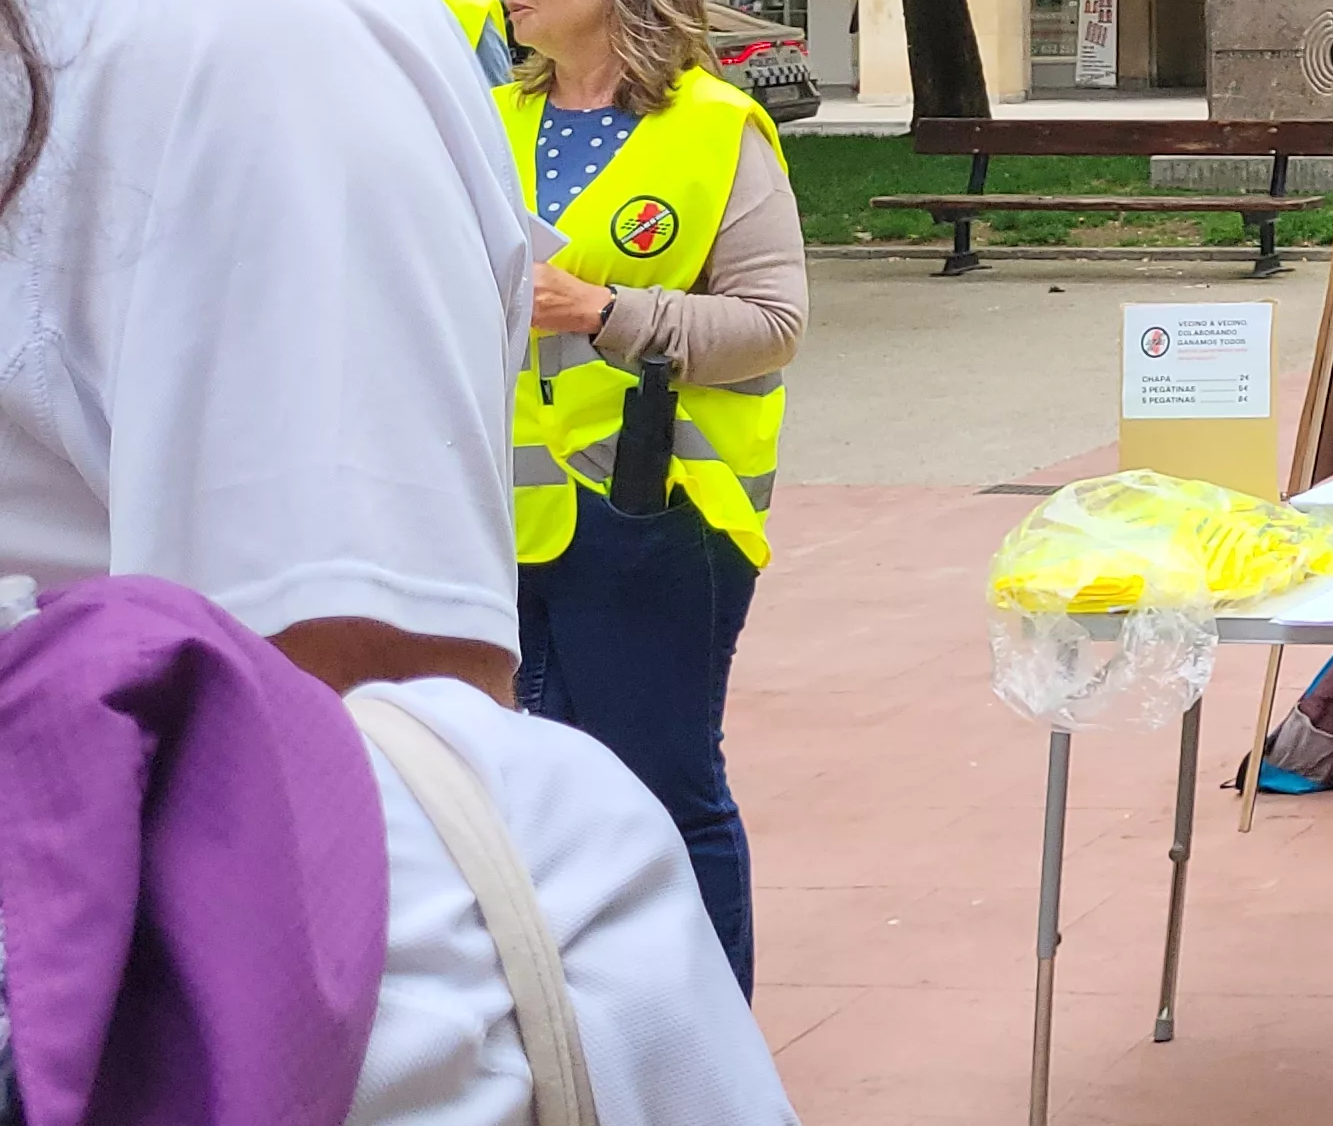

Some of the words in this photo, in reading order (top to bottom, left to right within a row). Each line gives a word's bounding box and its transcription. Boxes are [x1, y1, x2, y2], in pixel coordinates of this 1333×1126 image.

[1178, 329, 1237, 337] COLABORANDO
[1177, 338, 1217, 346] GANAMOS
[1219, 338, 1246, 346] TODOS
[1141, 375, 1171, 383] CHAPA
[1149, 385, 1196, 393] PEGATINAS
[1149, 396, 1196, 404] PEGATINAS
